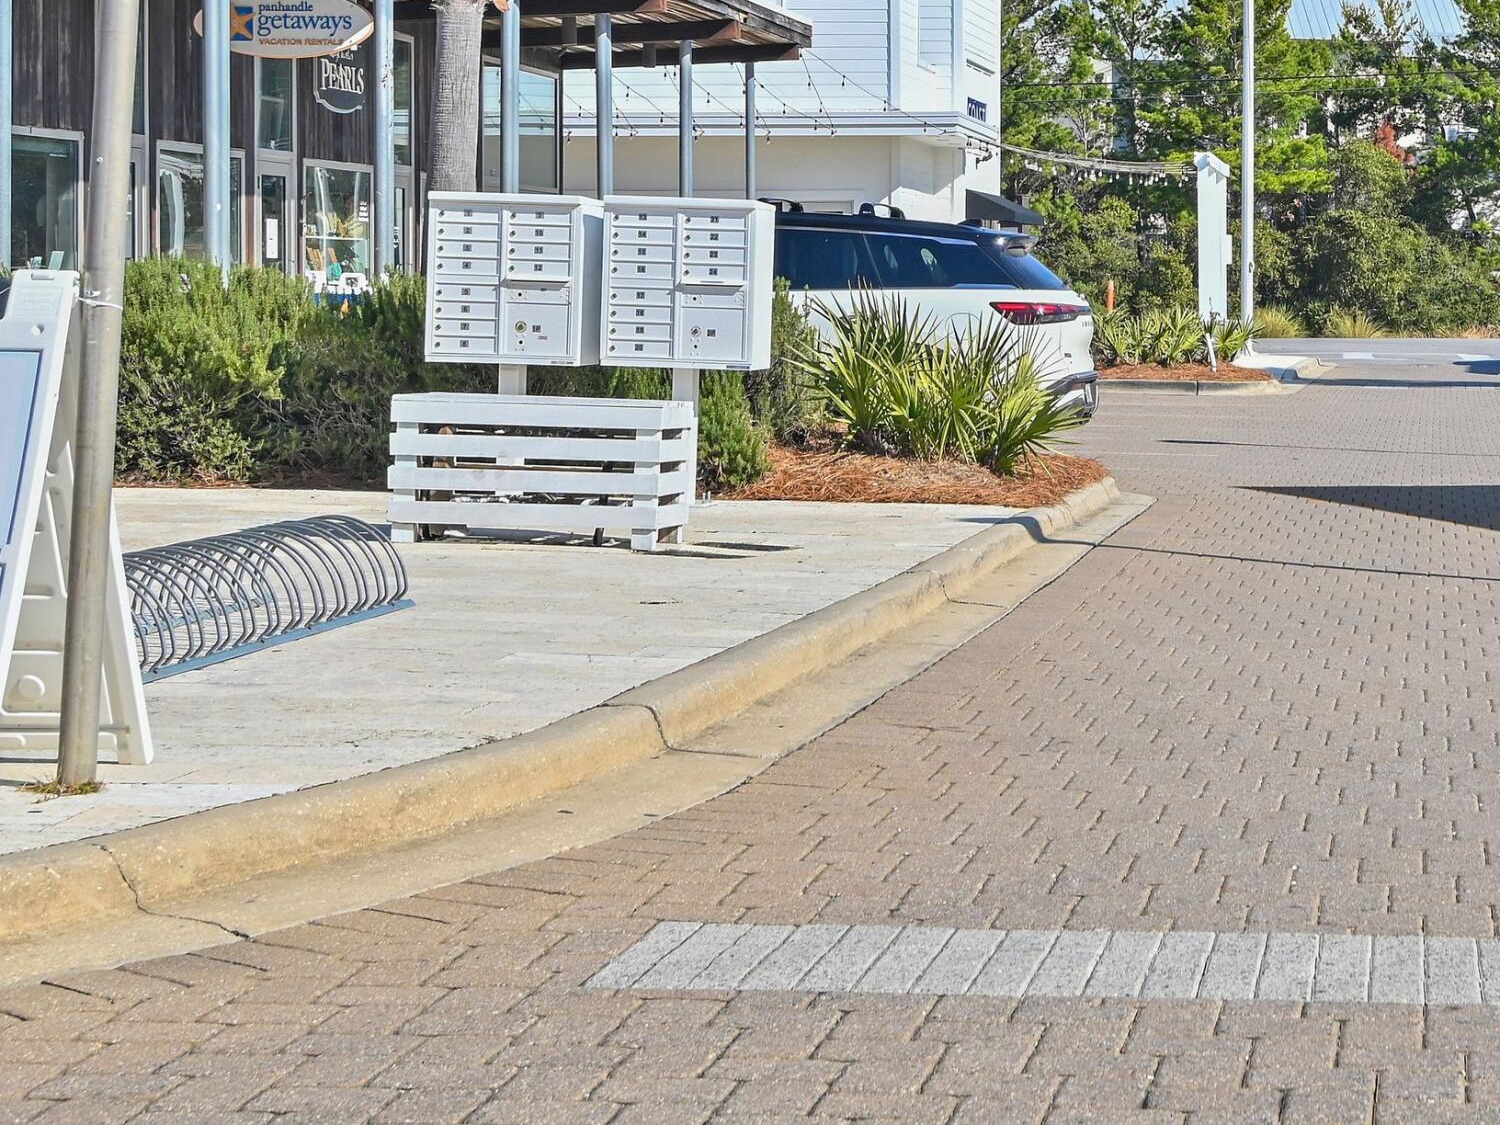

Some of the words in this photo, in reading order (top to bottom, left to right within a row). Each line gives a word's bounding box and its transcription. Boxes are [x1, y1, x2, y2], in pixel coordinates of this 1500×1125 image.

[258, 1, 313, 15] panhandle
[257, 13, 352, 37] getaways
[304, 38, 344, 46] RENTALS
[320, 58, 364, 94] PEARLS
